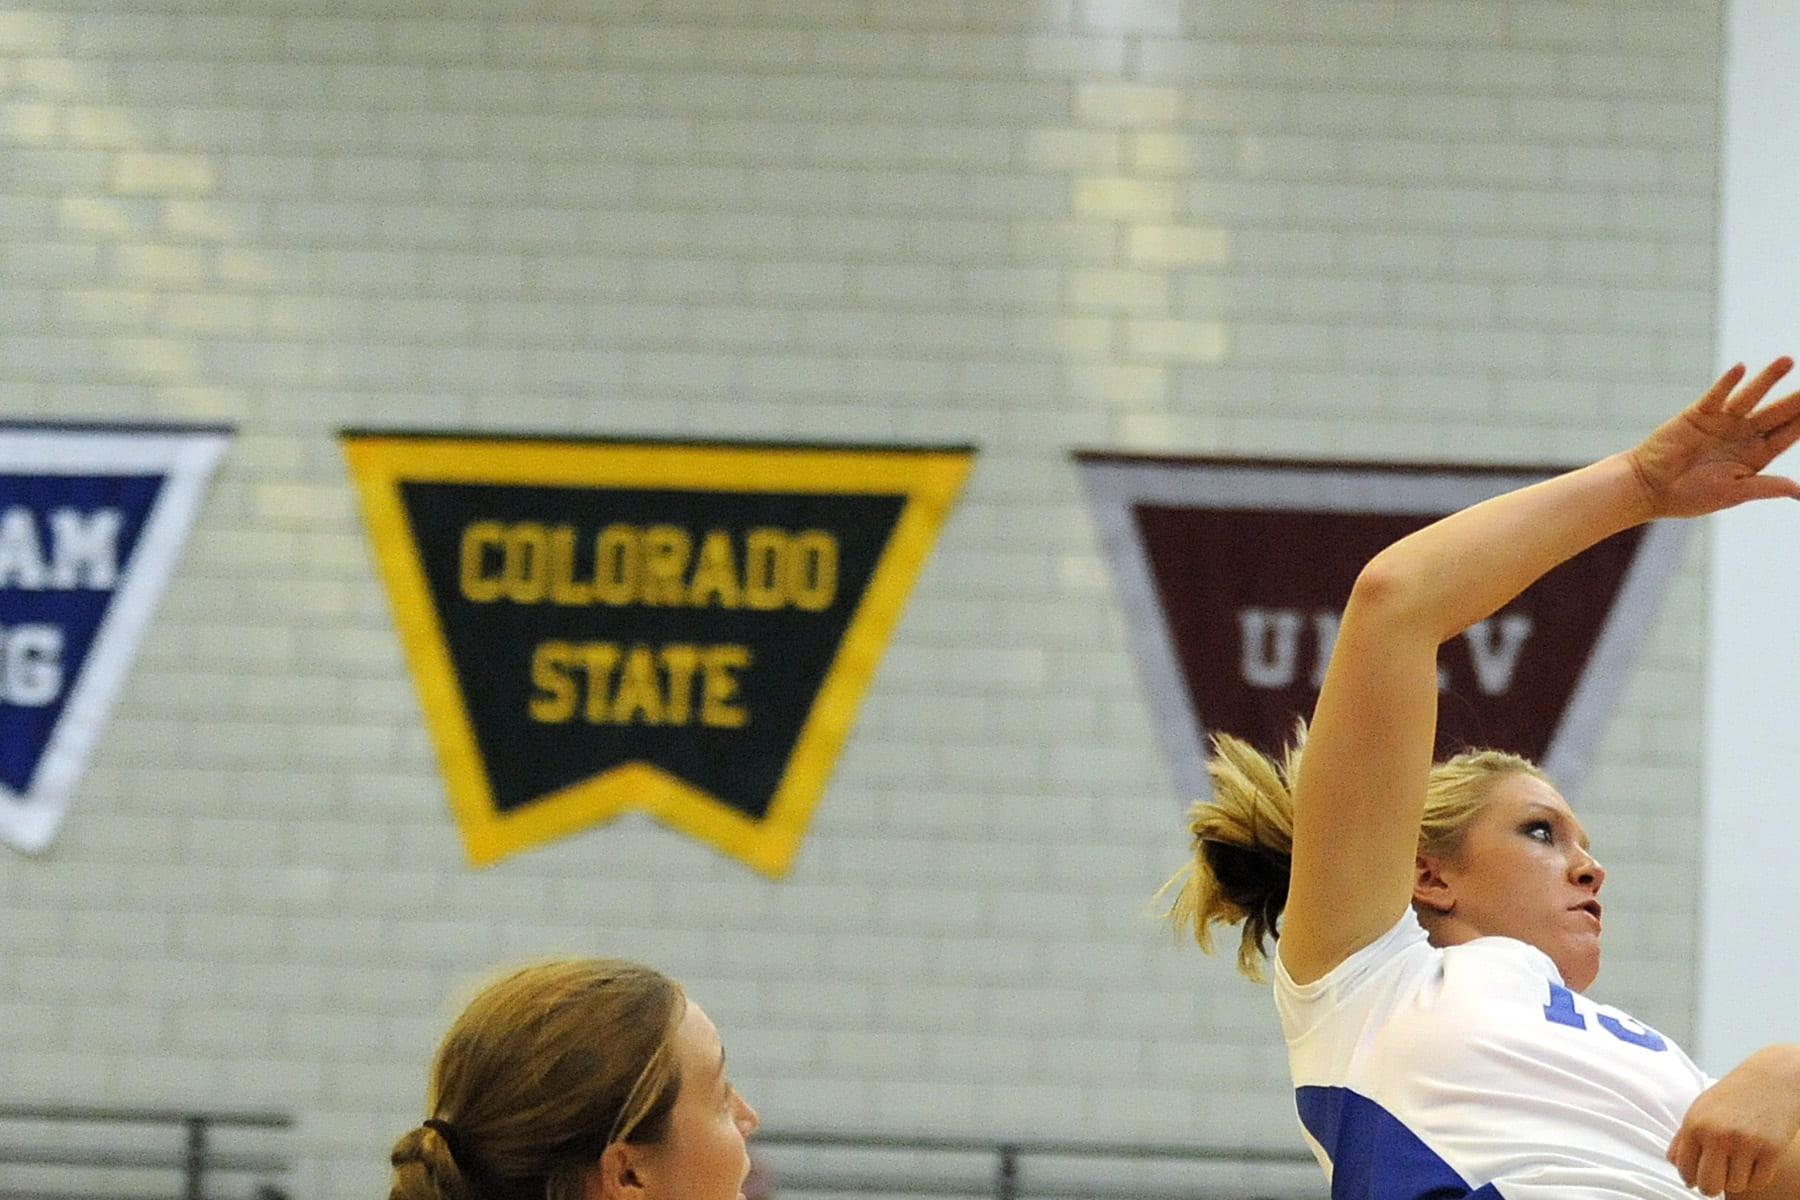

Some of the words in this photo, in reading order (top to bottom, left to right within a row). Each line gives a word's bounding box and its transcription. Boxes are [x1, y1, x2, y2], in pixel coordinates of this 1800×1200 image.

[459, 521, 839, 612] COLORADO
[528, 642, 750, 728] STATE
[1237, 606, 1534, 697] UV
